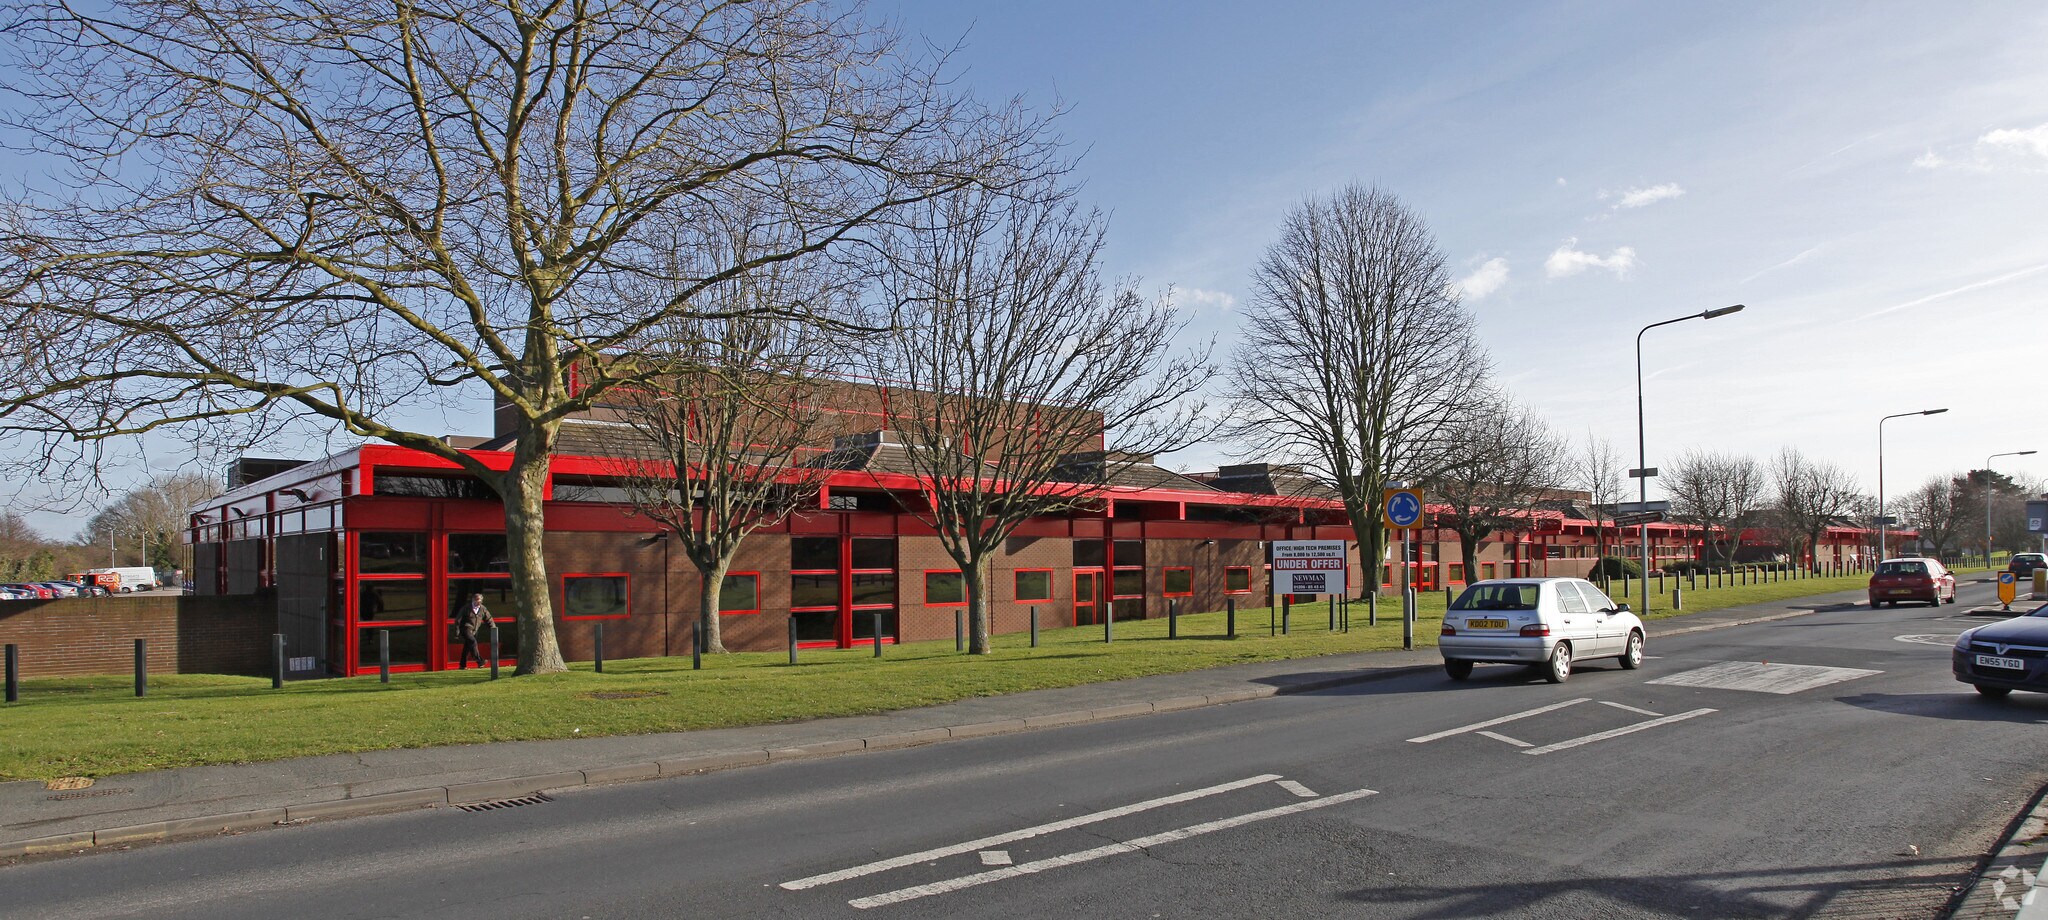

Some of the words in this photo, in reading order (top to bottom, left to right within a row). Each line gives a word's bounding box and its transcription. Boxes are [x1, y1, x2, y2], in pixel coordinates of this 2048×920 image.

[1277, 560, 1308, 568] UNDER
[1311, 560, 1340, 568] OFFER
[1979, 656, 2001, 666] EN55
